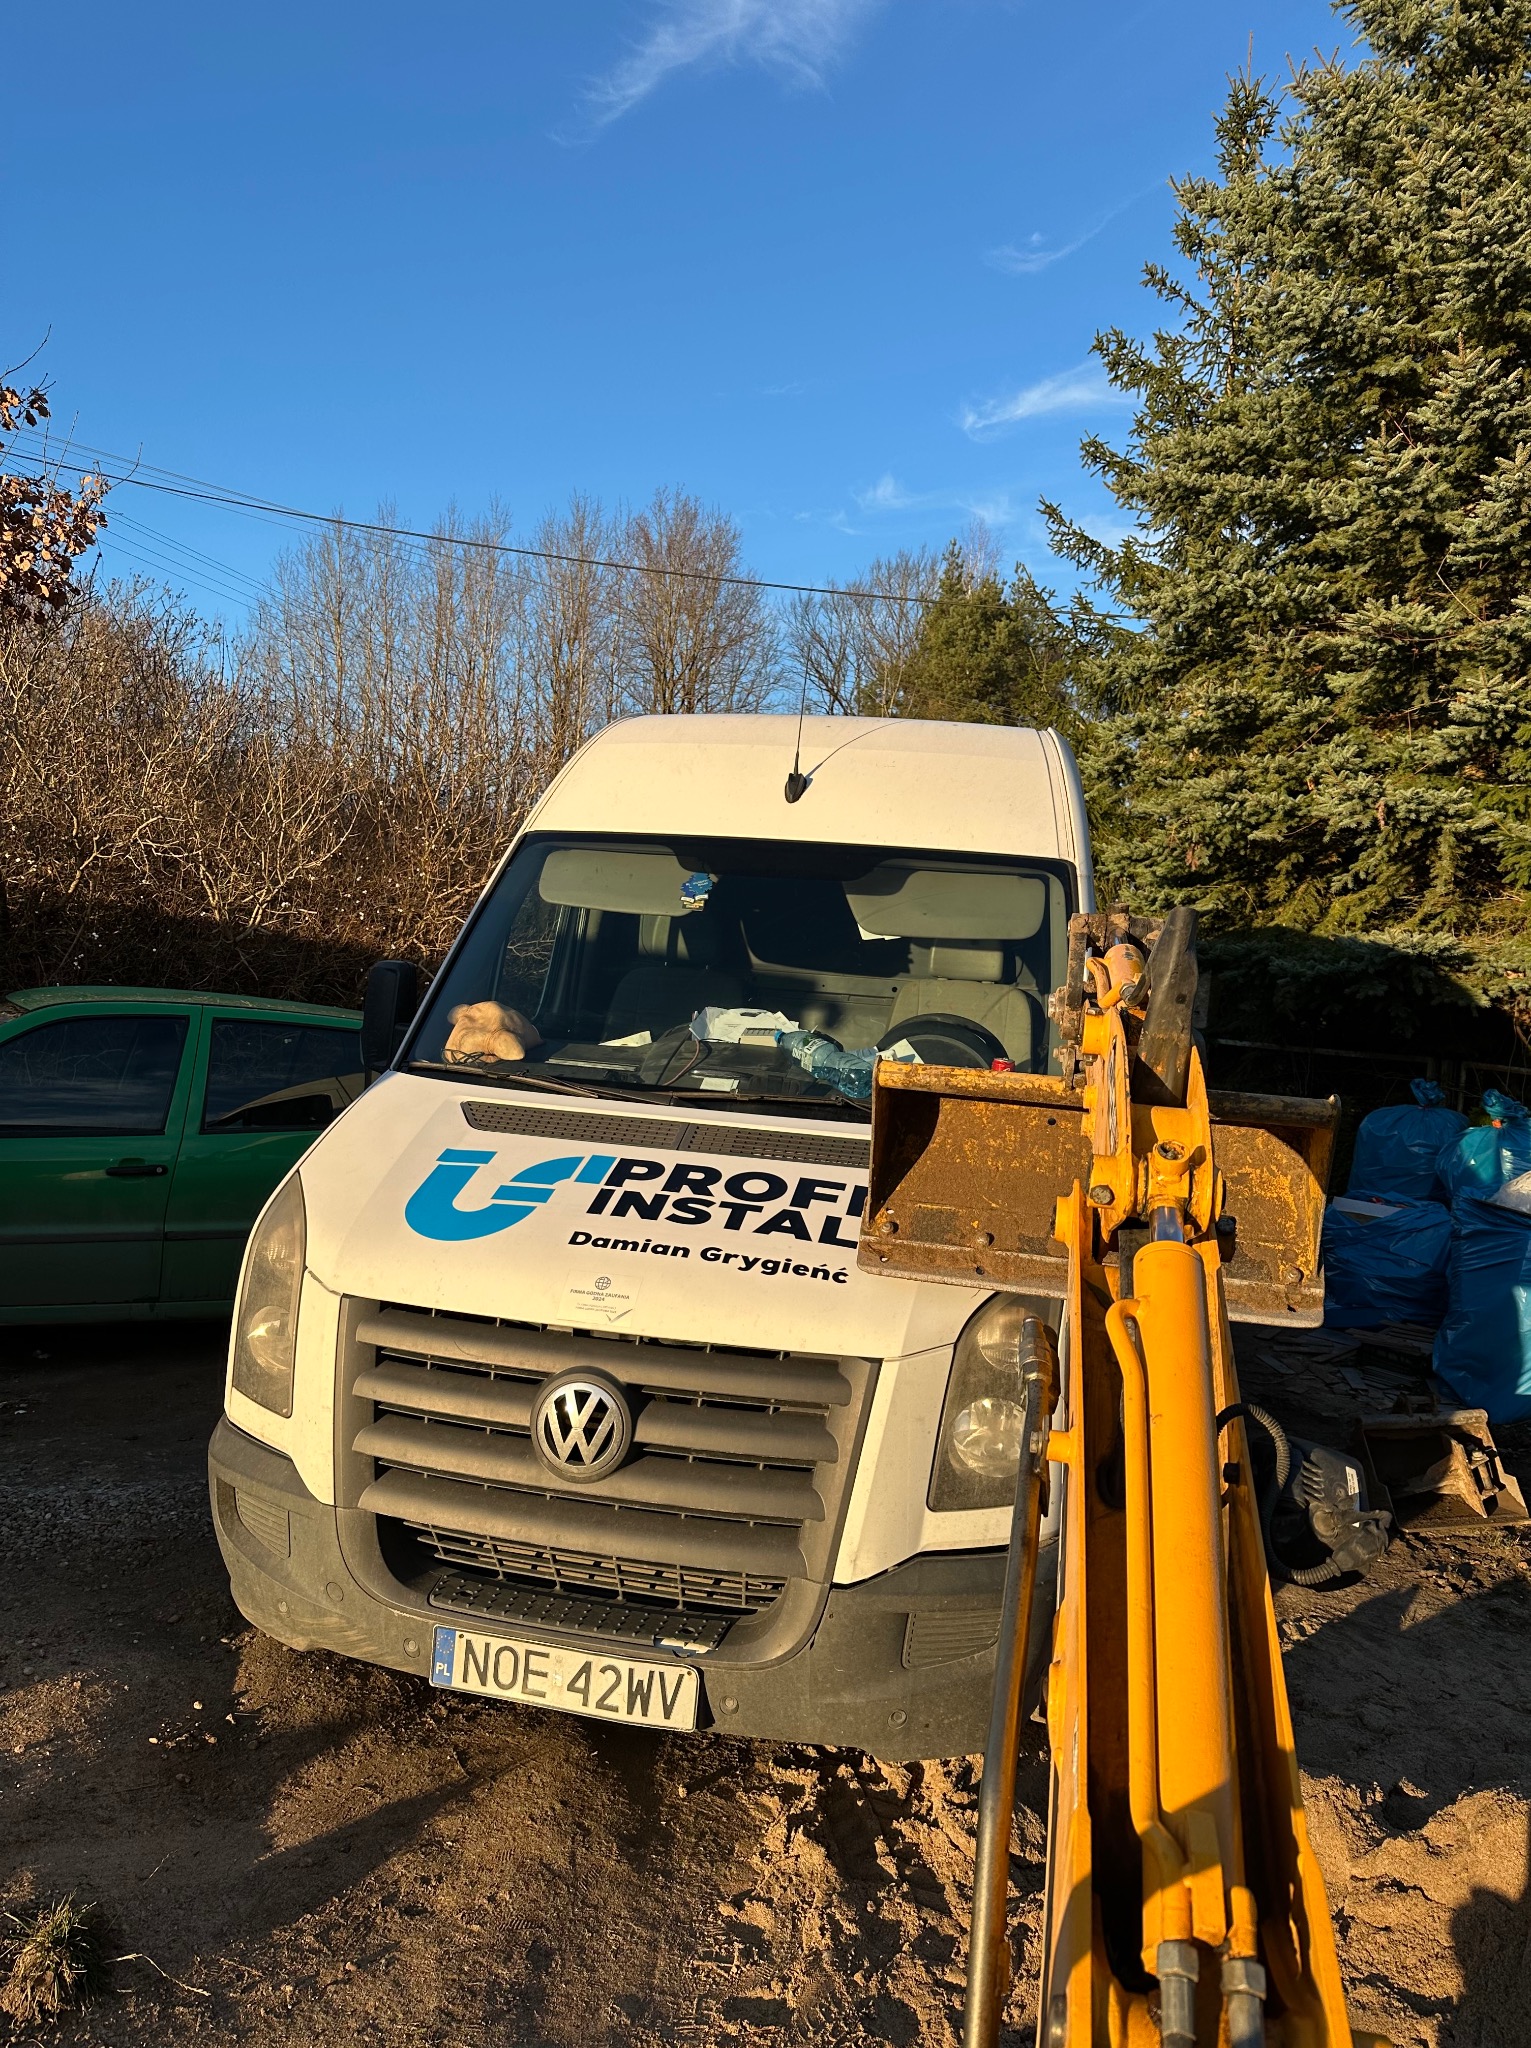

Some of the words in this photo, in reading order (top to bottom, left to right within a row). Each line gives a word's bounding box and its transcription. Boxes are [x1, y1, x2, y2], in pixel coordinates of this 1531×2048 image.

[604, 1158, 868, 1218] PROFI
[586, 1188, 859, 1250] INSTAL
[568, 1231, 691, 1259] Damian
[700, 1247, 849, 1284] Grygieńć
[539, 1381, 620, 1471] VW
[435, 1662, 450, 1677] PL
[462, 1639, 550, 1699] NOE
[566, 1660, 685, 1720] 42WV
